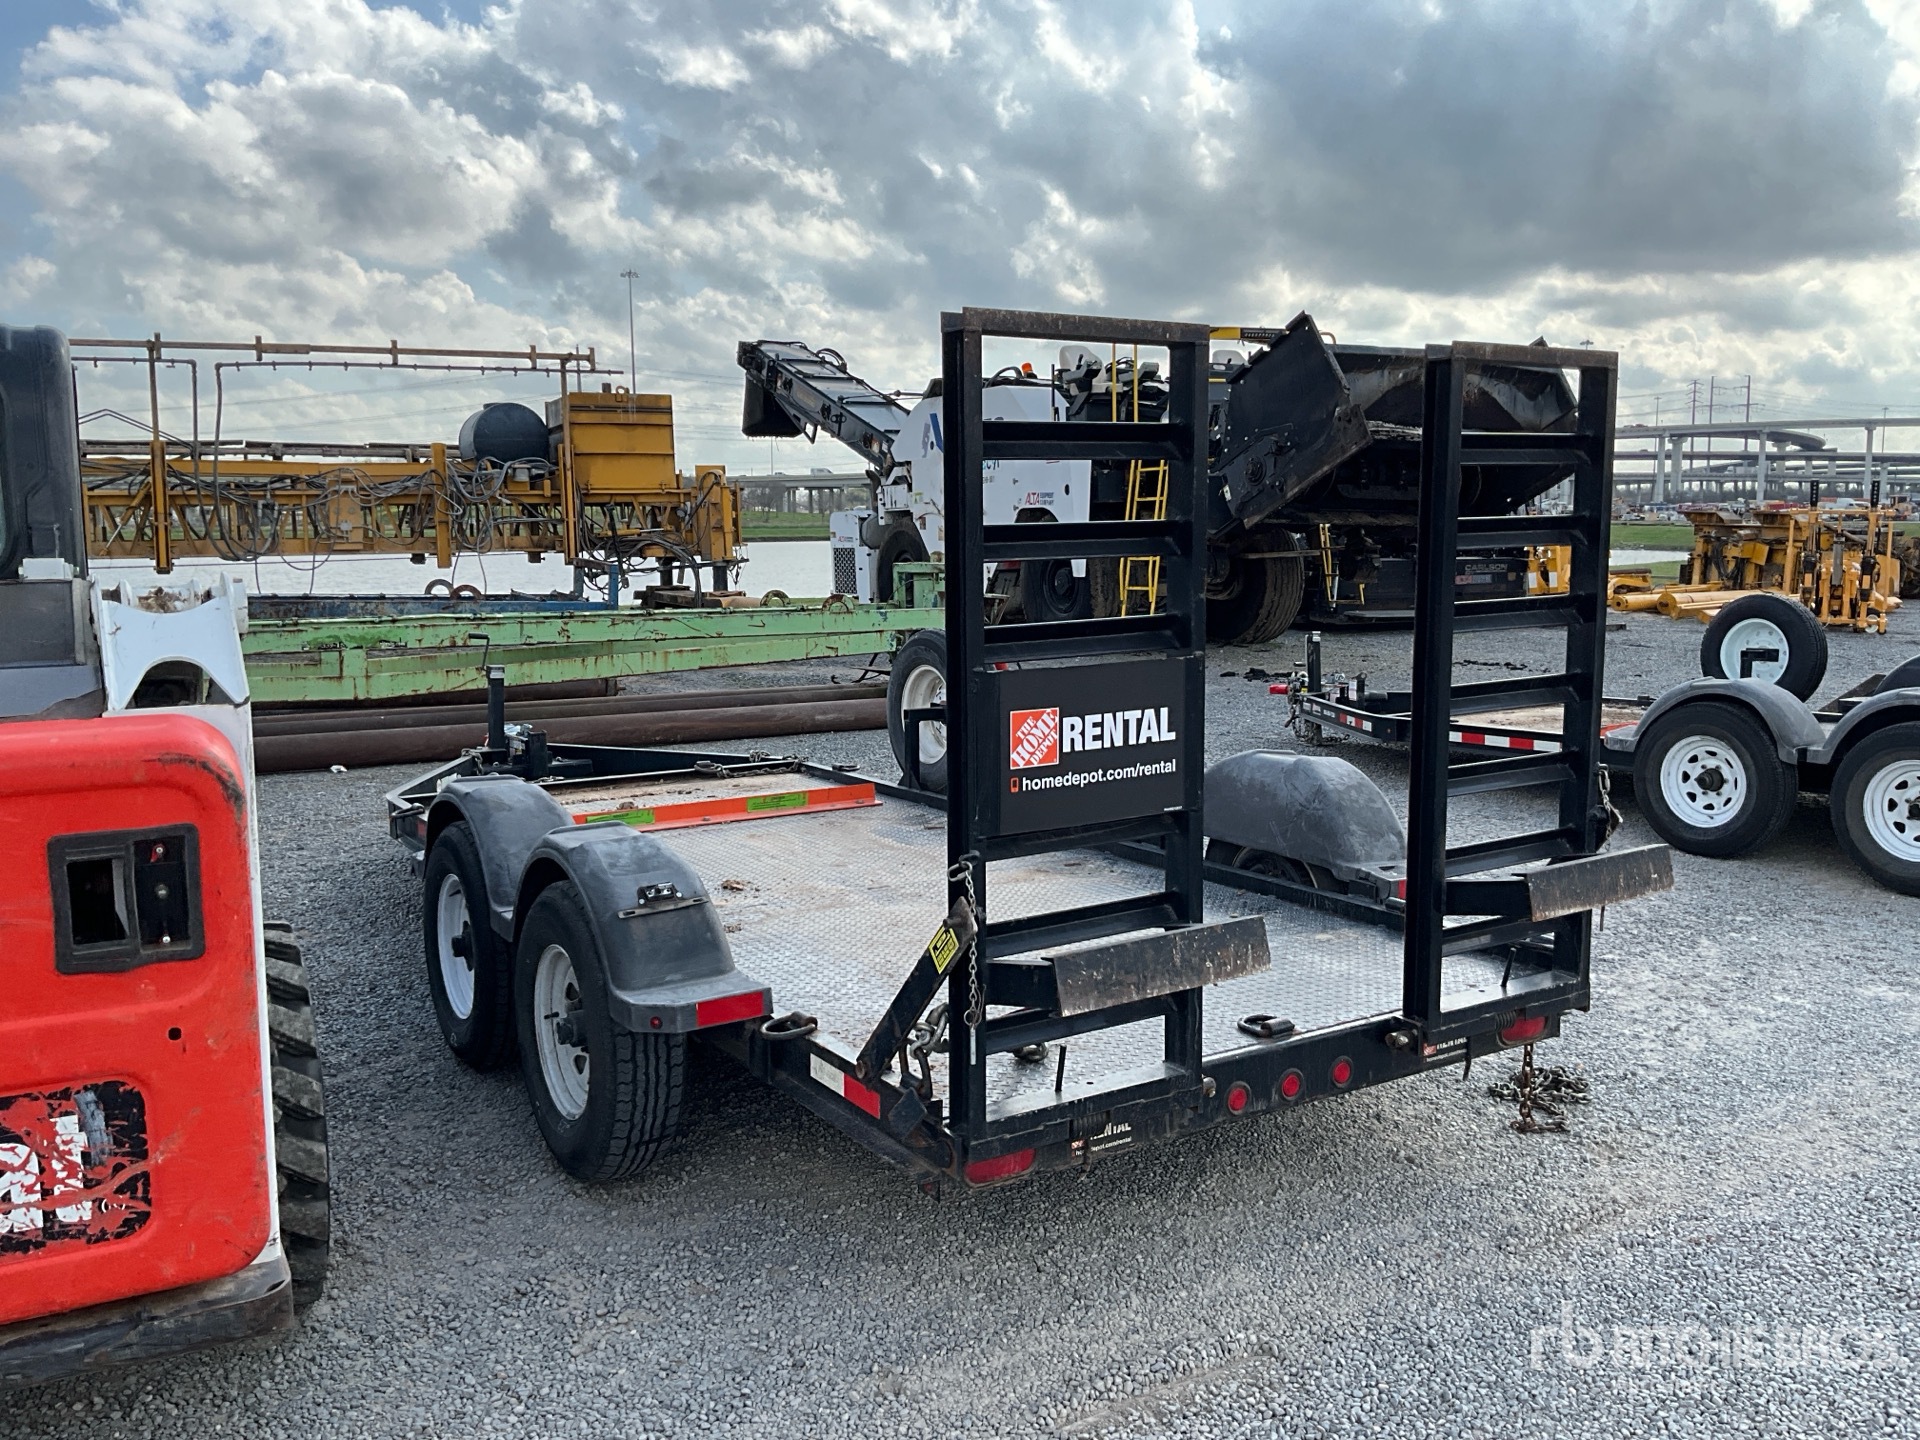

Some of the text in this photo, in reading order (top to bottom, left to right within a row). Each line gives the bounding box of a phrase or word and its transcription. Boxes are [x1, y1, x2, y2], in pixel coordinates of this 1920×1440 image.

[1010, 708, 1058, 768] HOME
[1016, 715, 1037, 740] THE
[1062, 707, 1176, 752] RENTAL
[1029, 729, 1058, 766] DEPOT
[1022, 759, 1176, 791] homedepot.com/rental
